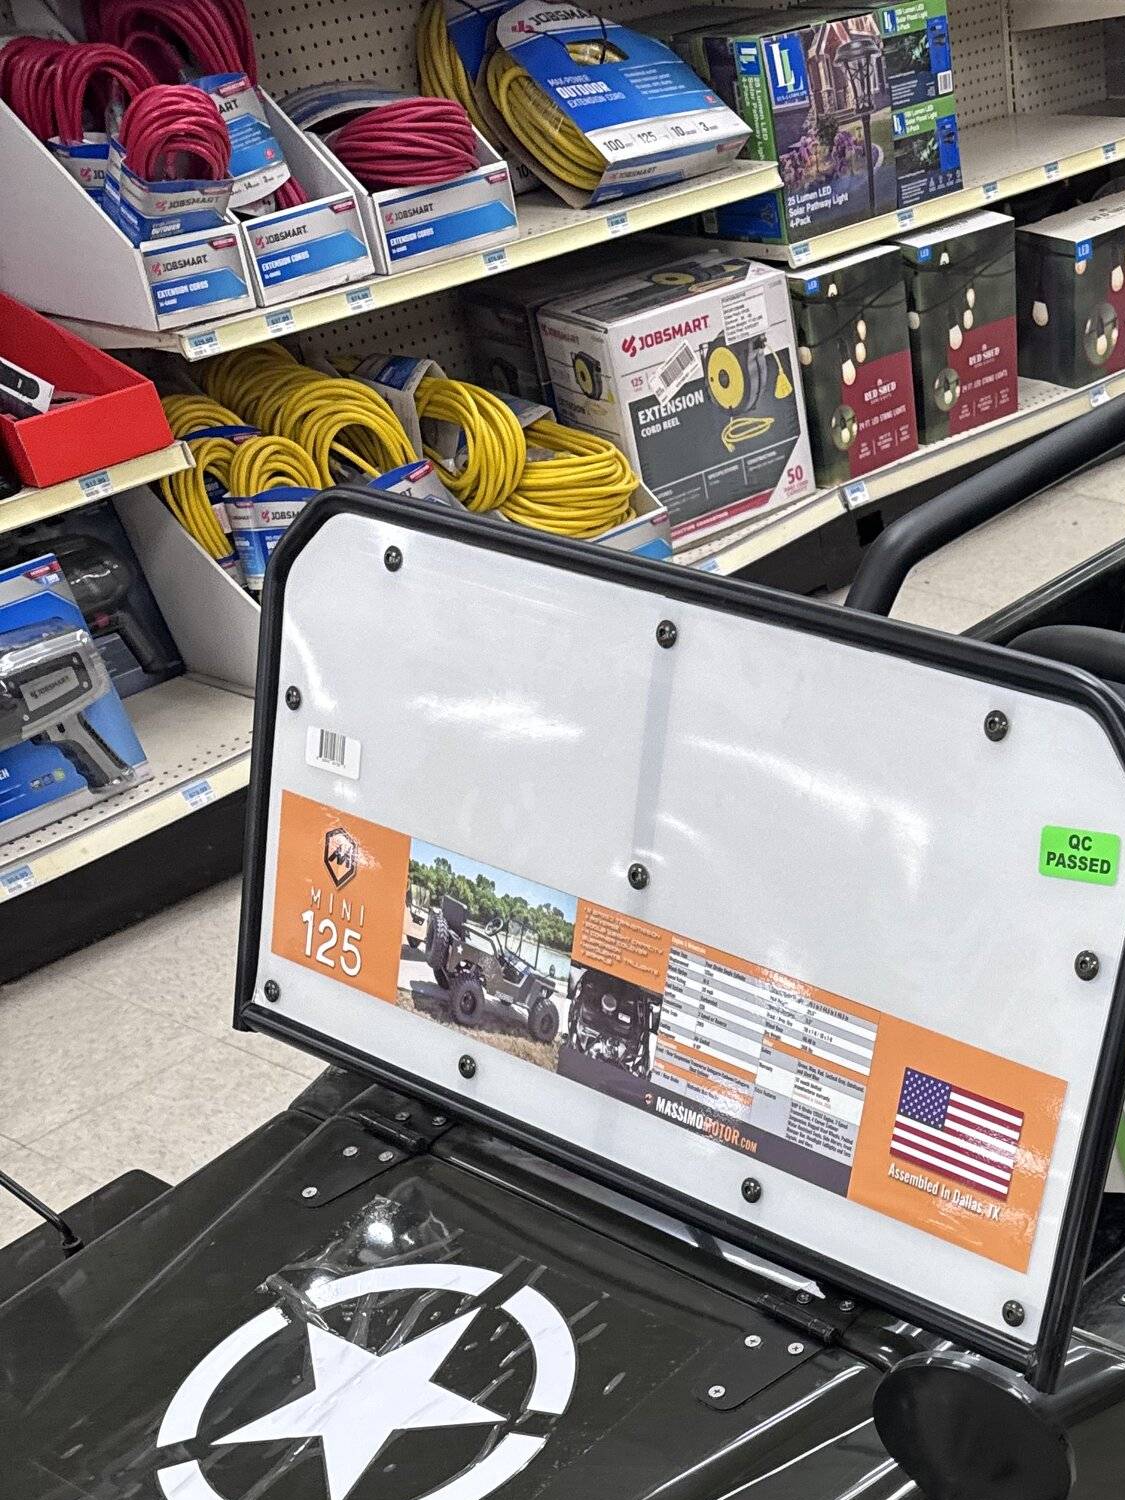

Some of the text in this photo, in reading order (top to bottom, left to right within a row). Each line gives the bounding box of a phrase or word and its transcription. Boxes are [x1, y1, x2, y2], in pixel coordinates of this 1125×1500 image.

[530, 8, 593, 26] JOBSMA
[556, 82, 611, 99] OUTDOOR
[603, 121, 709, 153] 100 125 10 3
[761, 122, 769, 141] LED
[168, 196, 220, 209] JOBSMART
[789, 192, 849, 217] Solar Pathway Light
[796, 191, 818, 204] Lumen
[818, 185, 832, 197] LED
[395, 203, 434, 221] JOBSMART
[789, 215, 812, 228] 4-Pack
[265, 225, 307, 245] JOBSMART
[1078, 243, 1090, 256] LED
[163, 254, 208, 273] JOBSMART
[639, 315, 710, 351] JOBSMART
[637, 390, 704, 425] EXTENSION
[641, 418, 681, 438] CORD REEL
[787, 464, 804, 484] 50
[1068, 834, 1092, 850] QC
[1046, 851, 1111, 875] PASSED
[311, 886, 364, 927] MINI
[301, 909, 362, 977] 125
[888, 1162, 1001, 1222] Assembled In Dallas, TX
